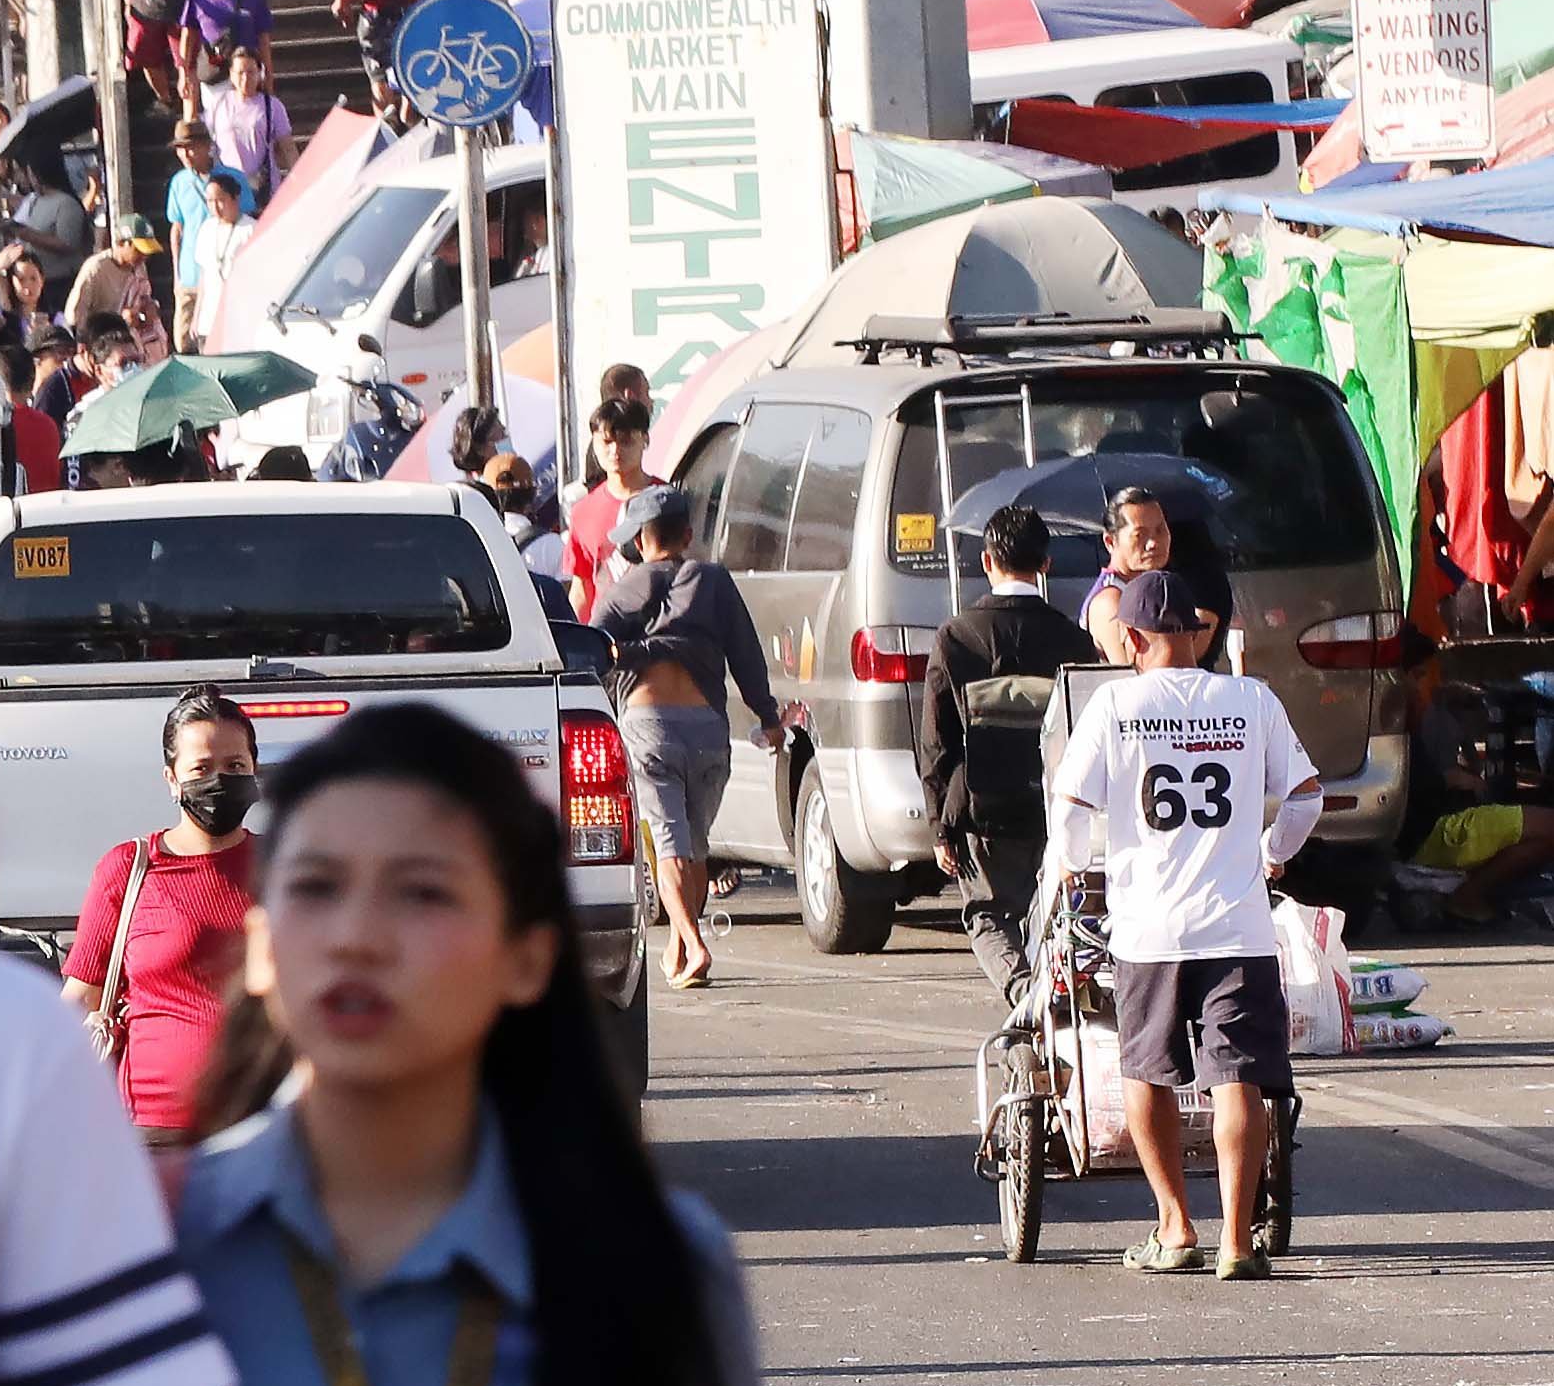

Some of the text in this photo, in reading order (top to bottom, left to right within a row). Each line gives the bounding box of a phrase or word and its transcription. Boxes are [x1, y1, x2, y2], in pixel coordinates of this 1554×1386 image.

[1379, 15, 1478, 40] WAITING
[628, 35, 742, 69] MARKET
[1379, 48, 1480, 76] VENDORS
[632, 73, 747, 111] MAIN
[1381, 85, 1467, 105] ANYTIME
[24, 547, 66, 567] V087
[1119, 717, 1246, 733] ERWIN TULFO
[0, 746, 68, 760] TOYOTA
[1143, 763, 1232, 831] 63
